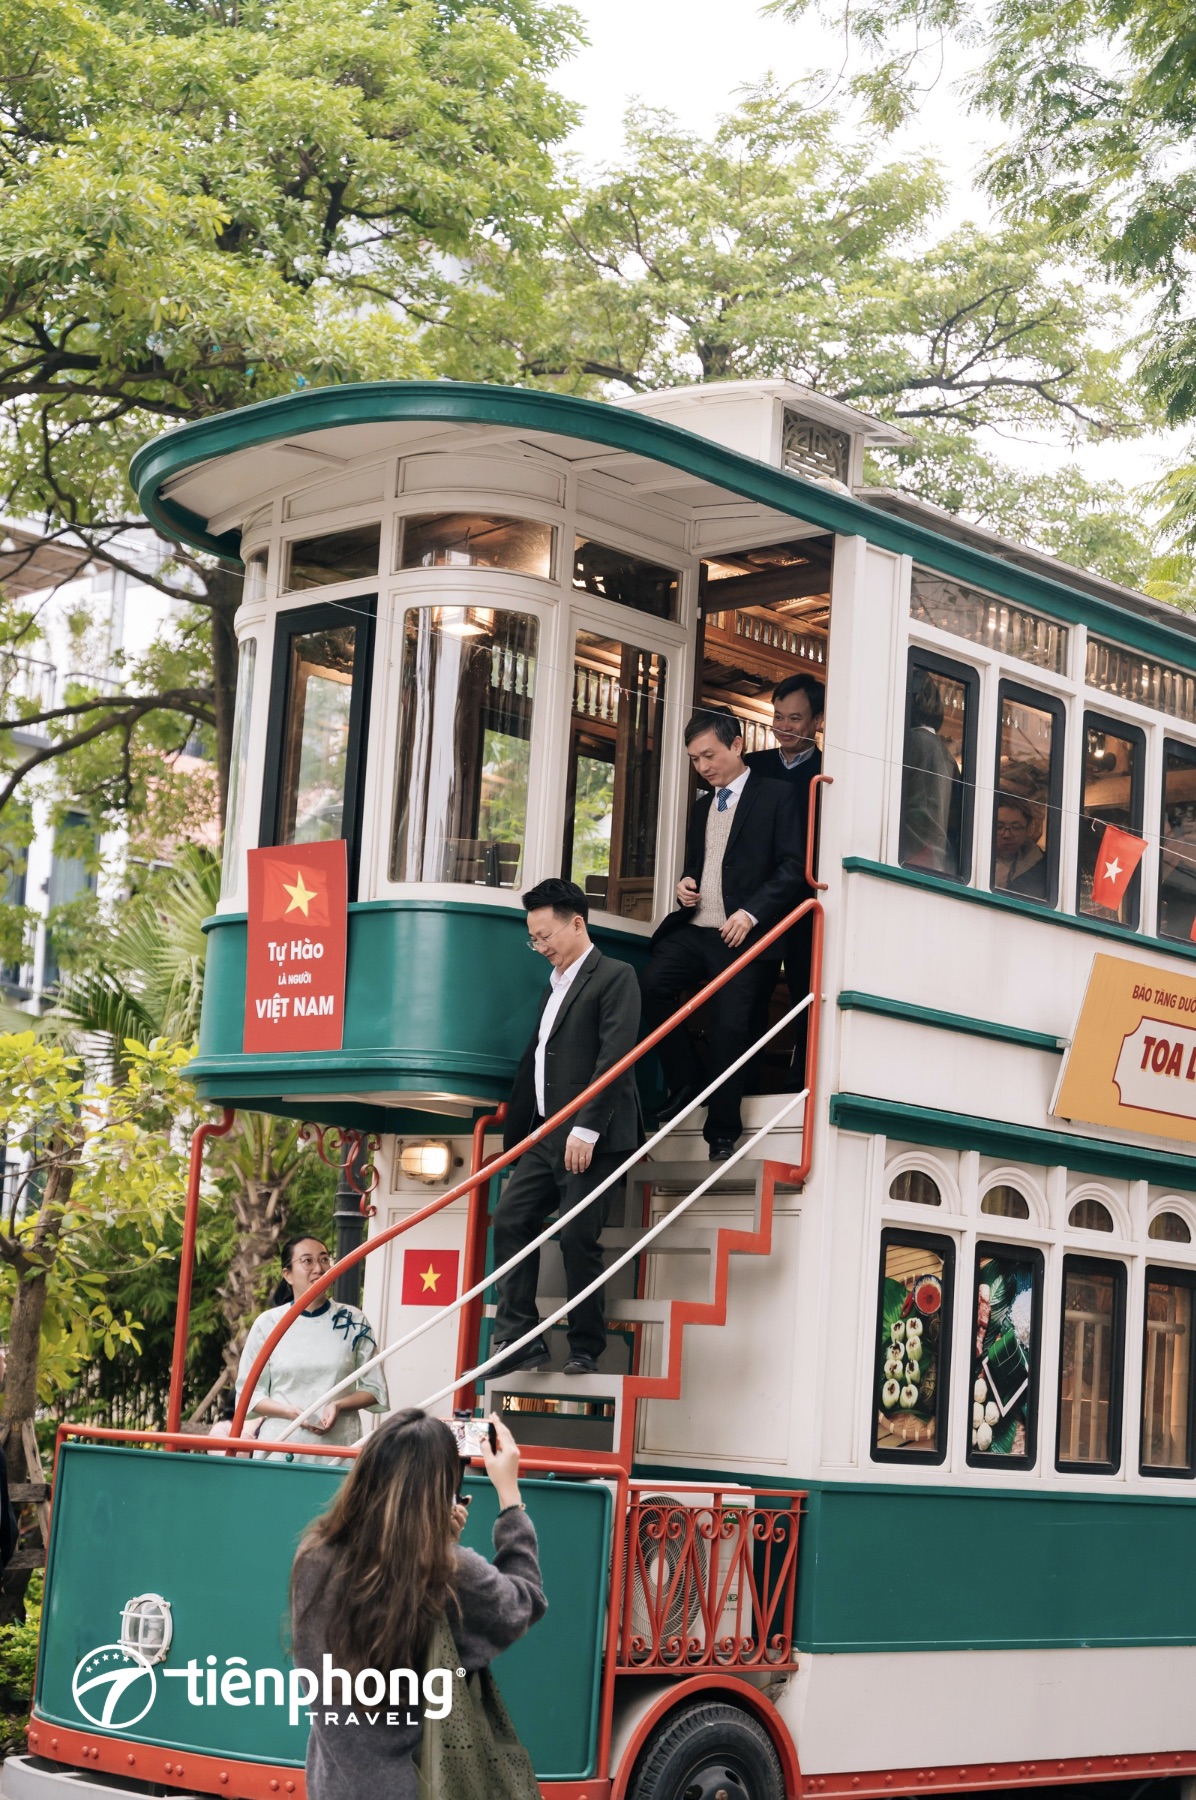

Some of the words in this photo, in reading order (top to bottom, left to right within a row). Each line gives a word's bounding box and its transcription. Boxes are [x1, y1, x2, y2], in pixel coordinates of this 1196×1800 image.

[268, 942, 287, 967] Tự
[290, 938, 324, 960] Hào
[278, 972, 287, 985] LÀ
[288, 971, 312, 985] NGƯỜI
[255, 993, 290, 1024] VIỆT
[293, 995, 334, 1017] NAM
[1153, 989, 1178, 1008] TÀNG
[1140, 1035, 1184, 1078] TOA
